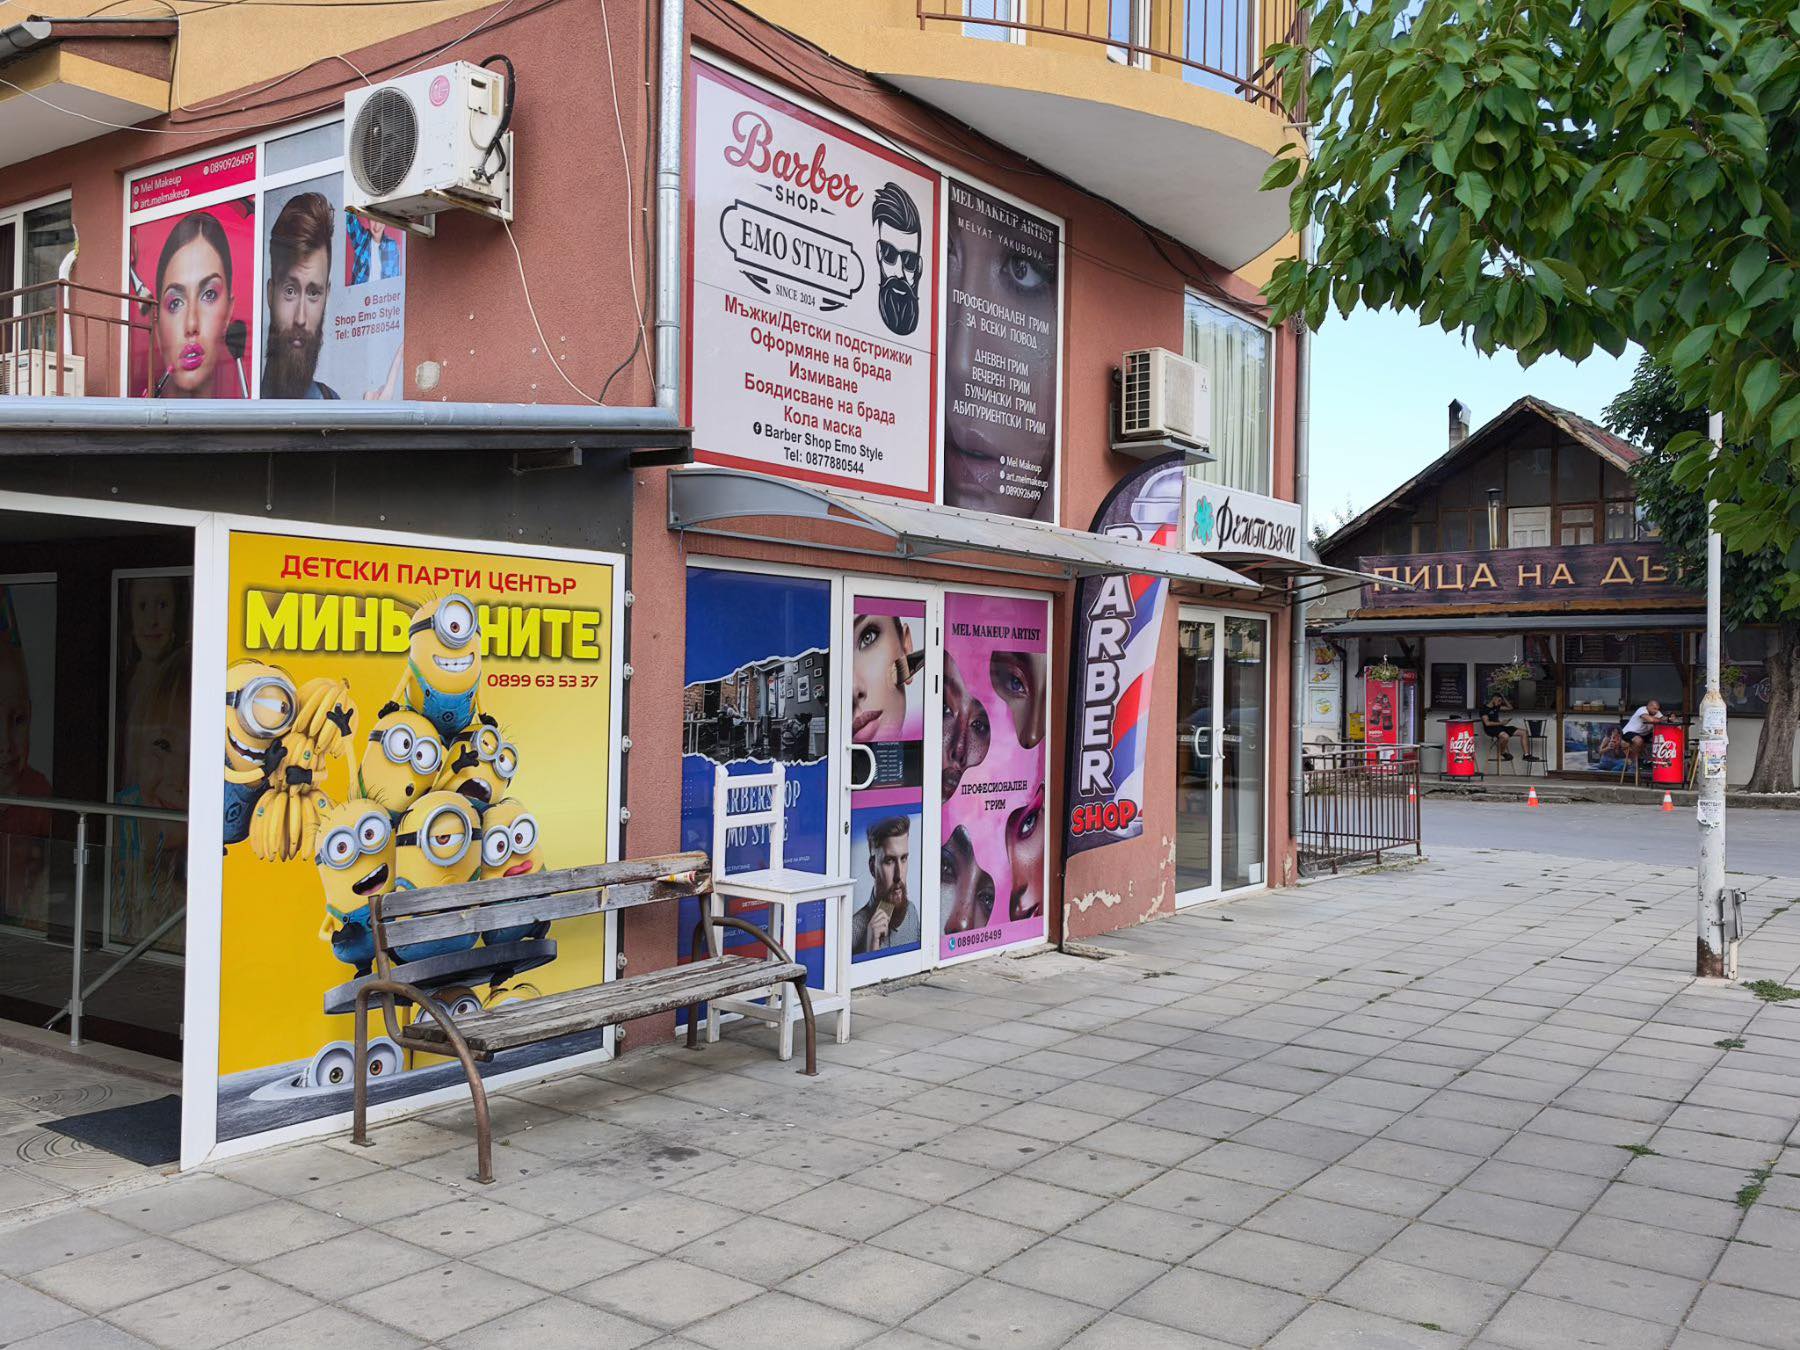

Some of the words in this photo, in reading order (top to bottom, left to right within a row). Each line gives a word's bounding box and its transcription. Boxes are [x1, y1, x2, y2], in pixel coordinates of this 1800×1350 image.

[209, 152, 255, 174] 0890926499
[724, 110, 864, 208] Barber
[140, 182, 153, 193] Mel
[154, 175, 182, 191] Makeup
[775, 184, 819, 213] SHOP
[951, 186, 974, 210] MEL
[975, 198, 1019, 228] MAKEUP
[1020, 218, 1054, 243] ARTIST
[741, 218, 788, 260] EMO
[791, 237, 850, 282] STYLE
[957, 216, 993, 239] MELYAT
[998, 234, 1043, 261] YAKUBOVA
[372, 293, 400, 305] Barber
[775, 284, 799, 302] SINCE
[799, 293, 817, 307] 2024
[335, 315, 356, 326] Shop
[358, 311, 377, 322] Emo
[379, 306, 401, 320] Style
[952, 289, 1026, 327] ПРОФЕСИОНАЛЕН
[1028, 315, 1050, 336] ГРИМ
[335, 328, 350, 340] Tel:
[351, 320, 400, 338] 0877880544
[724, 294, 831, 342] Мъжки/Детски
[835, 332, 912, 367] подстрижки
[966, 312, 977, 329] ЗА
[980, 317, 1007, 339] ВСЕКИ
[1010, 328, 1038, 349] ПОВОД
[750, 326, 830, 364] Оформяне
[833, 353, 849, 370] на
[853, 357, 892, 381] брада
[974, 348, 1006, 370] ДНЕВЕН
[1007, 358, 1029, 377] ГРИМ
[789, 360, 858, 393] Измиване
[972, 366, 1006, 388] ВЕЧЕРЕН
[1009, 377, 1031, 396] ГРИМ
[744, 372, 834, 410] Боядисване
[838, 399, 853, 415] на
[857, 401, 896, 425] брада
[964, 383, 1012, 409] БУЛЧИНСКИ
[1015, 397, 1036, 415] ГРИМ
[783, 405, 818, 429] Кола
[822, 418, 862, 438] маска
[952, 399, 1022, 429] АБИТУРИЕНТСКИ
[1025, 418, 1046, 435] ГРИМ
[765, 423, 802, 445] Barber
[804, 432, 832, 451] Shop
[834, 439, 857, 455] Emo
[859, 444, 883, 462] Style
[783, 446, 802, 463] Tel:
[805, 451, 865, 475] 0877880544
[1006, 456, 1018, 467] Mel
[1019, 459, 1042, 475] Makeup
[1005, 485, 1041, 500] 0890926499
[281, 555, 389, 584] ДЕТСКИ
[397, 564, 481, 589] ПАРТИ
[488, 571, 577, 595] ЦЕНТЪР
[1373, 562, 1498, 592] ПИЦА
[1517, 563, 1576, 587] НА
[951, 623, 971, 637] MEL
[972, 624, 1010, 639] MAKEUP
[1010, 627, 1041, 641] ARTIST
[487, 674, 532, 688] 0899
[535, 674, 555, 688] 63
[558, 675, 578, 688] 53
[580, 676, 599, 688] 37
[961, 780, 1028, 795] ПРОФЕСИОНАЛЕН
[984, 799, 1007, 811] ГРИМ
[1072, 801, 1137, 838] SHOP
[726, 825, 748, 848] MO
[957, 929, 1002, 948] 0890926499
